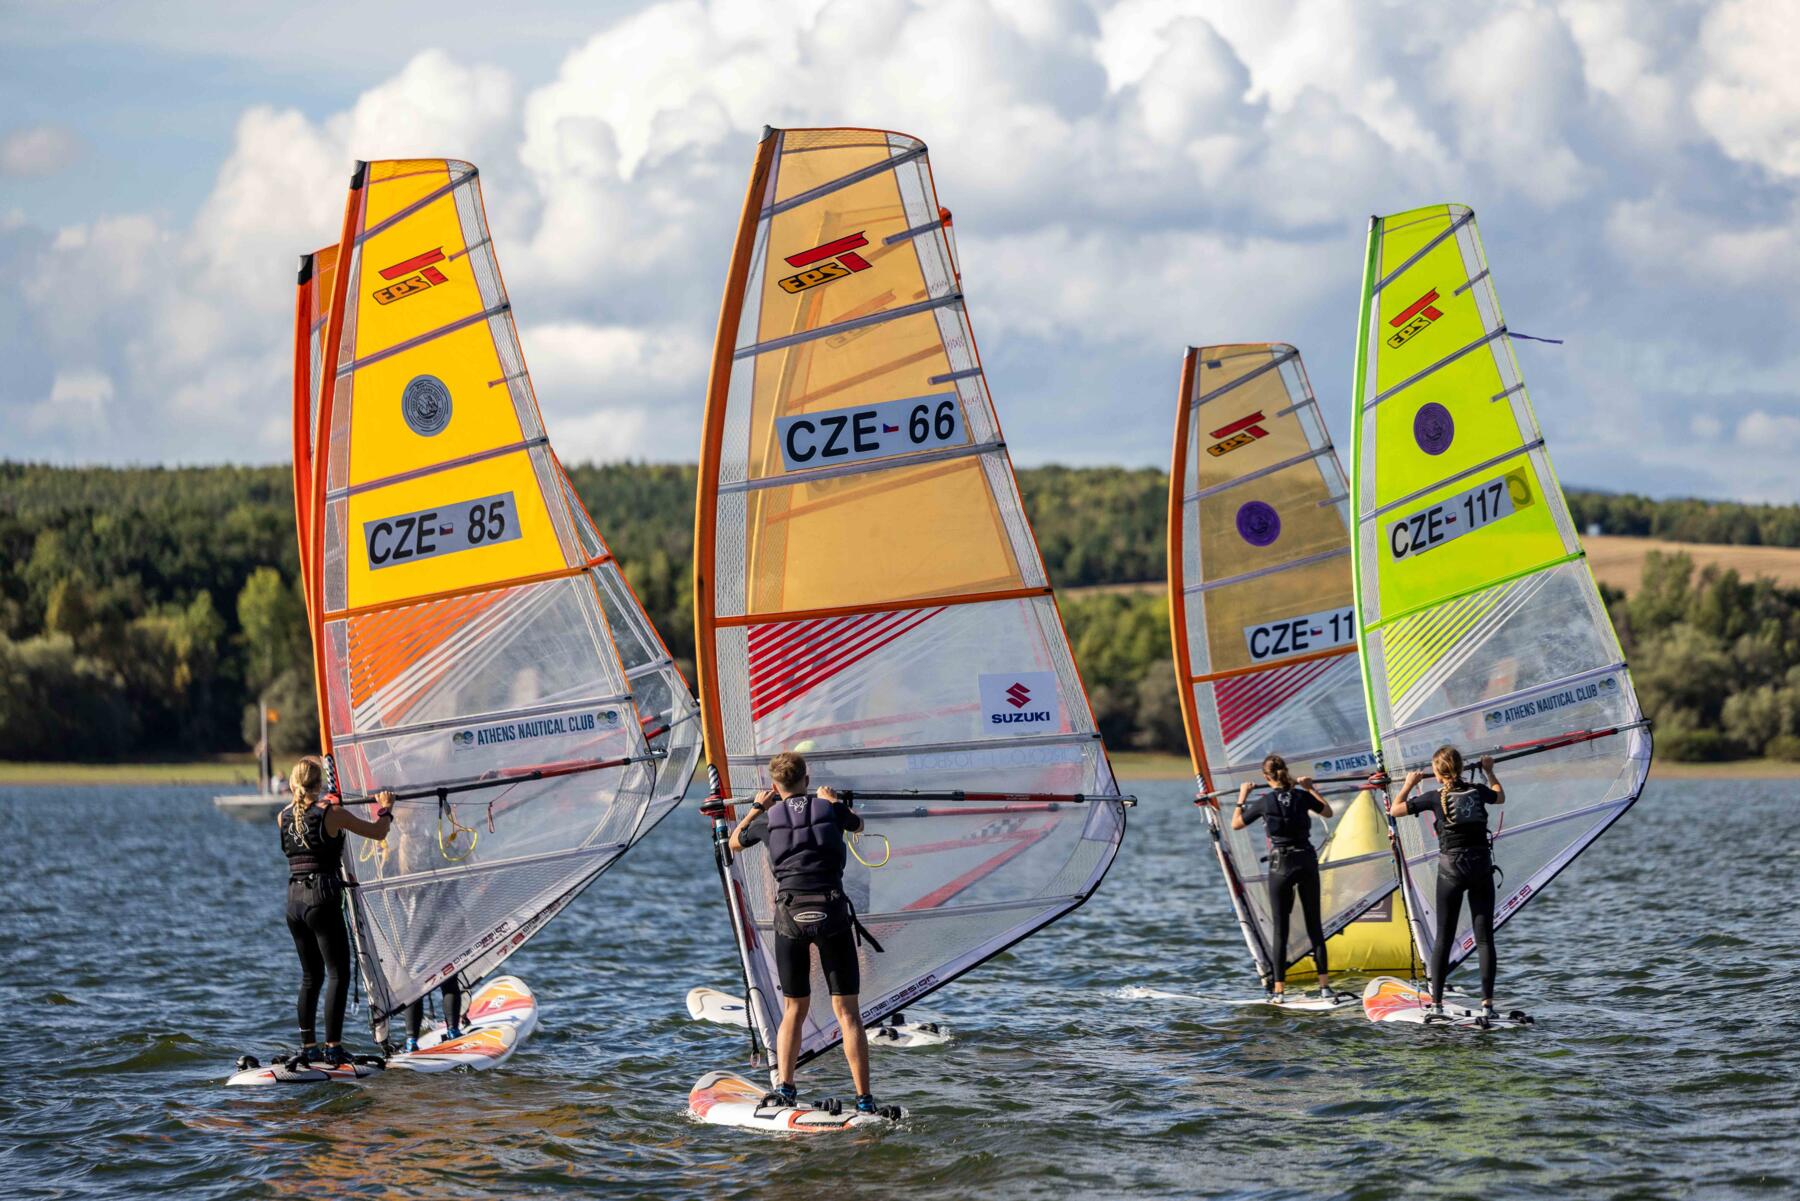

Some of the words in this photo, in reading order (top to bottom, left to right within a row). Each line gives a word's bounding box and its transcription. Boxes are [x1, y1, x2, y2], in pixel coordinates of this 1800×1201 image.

[786, 411, 880, 464] CZE
[908, 399, 955, 444] 66
[369, 513, 438, 565] CZE
[467, 501, 505, 544] 85
[1391, 504, 1444, 559] CZE
[1464, 483, 1502, 528] 117
[1250, 619, 1309, 659] CZE
[991, 711, 1050, 724] SUZUKI
[1504, 702, 1535, 723] ATHENS
[1536, 691, 1577, 712] NAUTICAL
[1576, 684, 1598, 702] CLUB
[478, 725, 515, 745] ATHENS
[518, 718, 566, 739] NAUTICAL
[569, 714, 595, 732] CLUB
[1335, 755, 1369, 772] ATHENS
